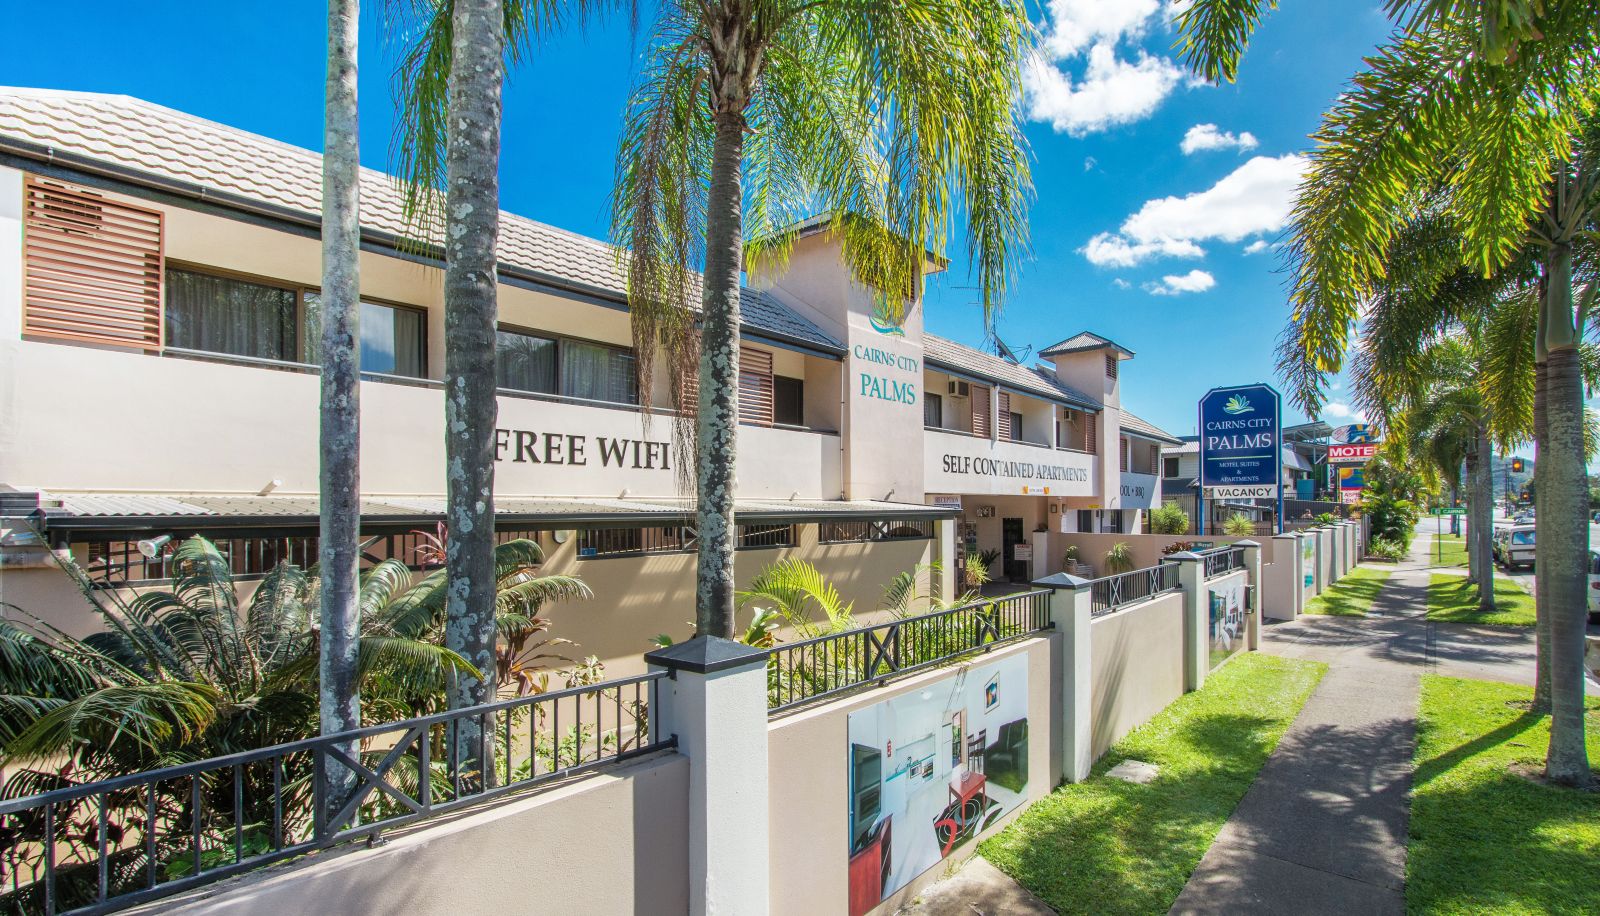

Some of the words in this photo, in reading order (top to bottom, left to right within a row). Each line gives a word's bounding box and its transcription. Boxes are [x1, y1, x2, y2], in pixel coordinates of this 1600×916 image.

[854, 344, 896, 367] CAIRNS
[897, 355, 919, 373] CITY
[860, 373, 916, 405] PALMS
[1206, 419, 1246, 431] CAIRNS
[1247, 417, 1273, 428] CITY
[494, 428, 588, 467] FREE
[595, 436, 671, 470] WIFI
[1207, 432, 1272, 451] PALMS
[943, 454, 971, 475] SELF
[973, 456, 1034, 479] CONTAINED
[1036, 463, 1088, 482] APARTMENTS
[1240, 460, 1260, 468] SUITES
[1217, 488, 1272, 497] VACANCY
